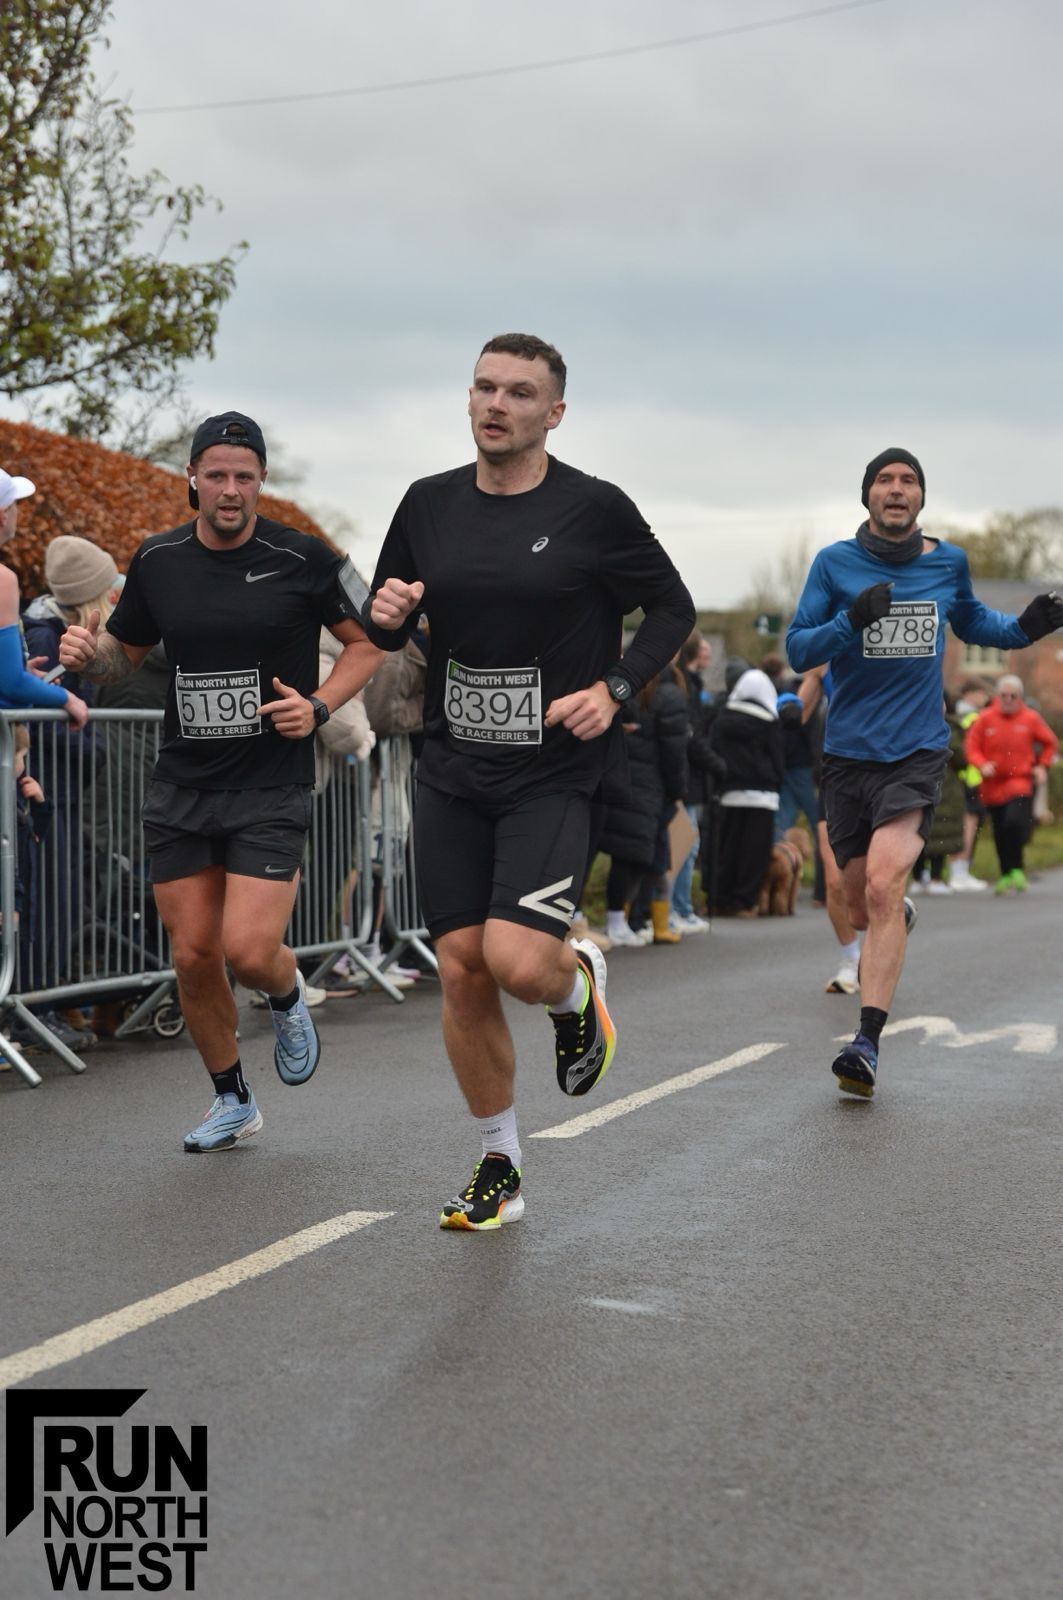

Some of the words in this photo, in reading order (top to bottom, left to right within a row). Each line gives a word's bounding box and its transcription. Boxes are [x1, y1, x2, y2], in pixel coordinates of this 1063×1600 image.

[913, 606, 932, 614] WEST
[867, 618, 935, 644] 8788
[195, 678, 227, 688] NORTH
[229, 675, 255, 686] WEST
[453, 667, 466, 682] RUN
[467, 673, 502, 685] NORTH
[505, 674, 534, 684] WEST
[181, 690, 257, 722] 5196
[448, 685, 537, 726] 8394
[188, 727, 199, 735] 10K
[200, 726, 223, 735] RACE
[224, 725, 253, 734] SERIES
[451, 725, 465, 736] 10K
[466, 728, 493, 739] RACE
[495, 731, 529, 740] SERIES
